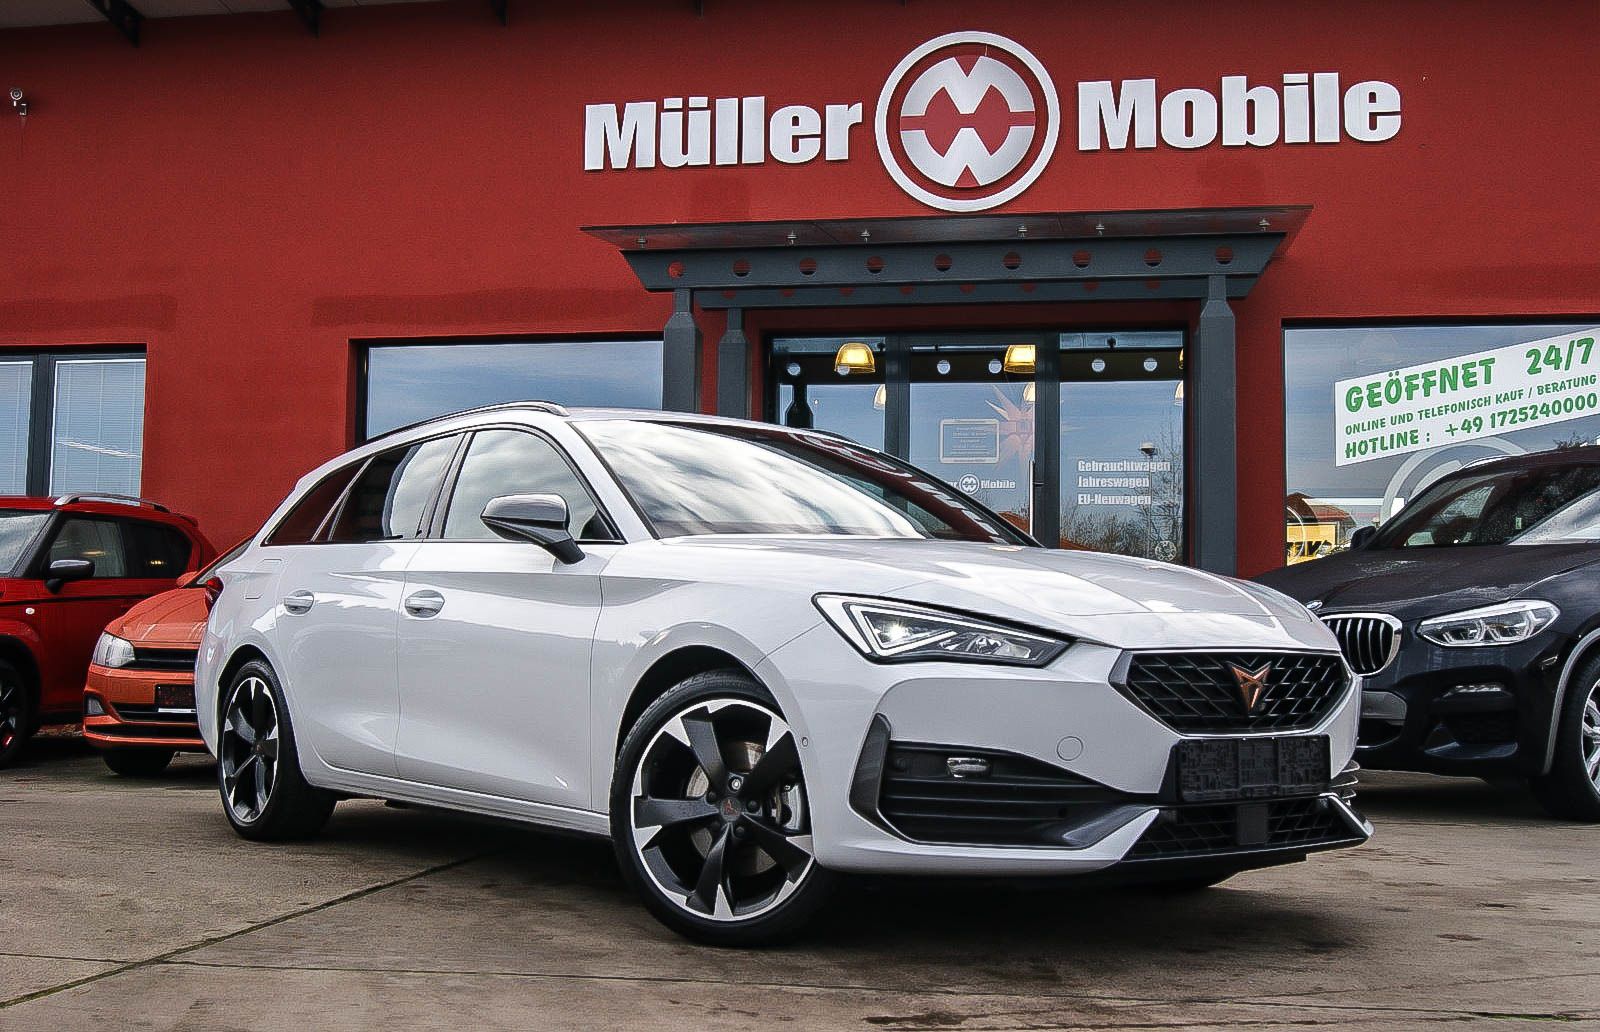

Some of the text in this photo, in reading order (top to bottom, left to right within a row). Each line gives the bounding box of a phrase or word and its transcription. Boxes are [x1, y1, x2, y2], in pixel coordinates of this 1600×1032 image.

[584, 71, 1402, 171] Müller Mobile
[1345, 337, 1595, 413] GEÖFFNET 24/7
[1345, 417, 1386, 436] ONLINE
[1390, 412, 1414, 426] UND
[1417, 395, 1491, 421] TELEFONISCH
[1495, 388, 1524, 405] KAUF
[1536, 374, 1597, 396] BERATUNG
[1345, 429, 1419, 459] HOTLINE
[1444, 415, 1484, 437] +49
[1490, 392, 1598, 429] 1725240000
[980, 479, 1017, 489] Mobile
[1077, 460, 1171, 473] Gebrauchtwagen
[1077, 475, 1150, 489] Jahreswagen
[1077, 493, 1152, 506] EU-Neuwagen
